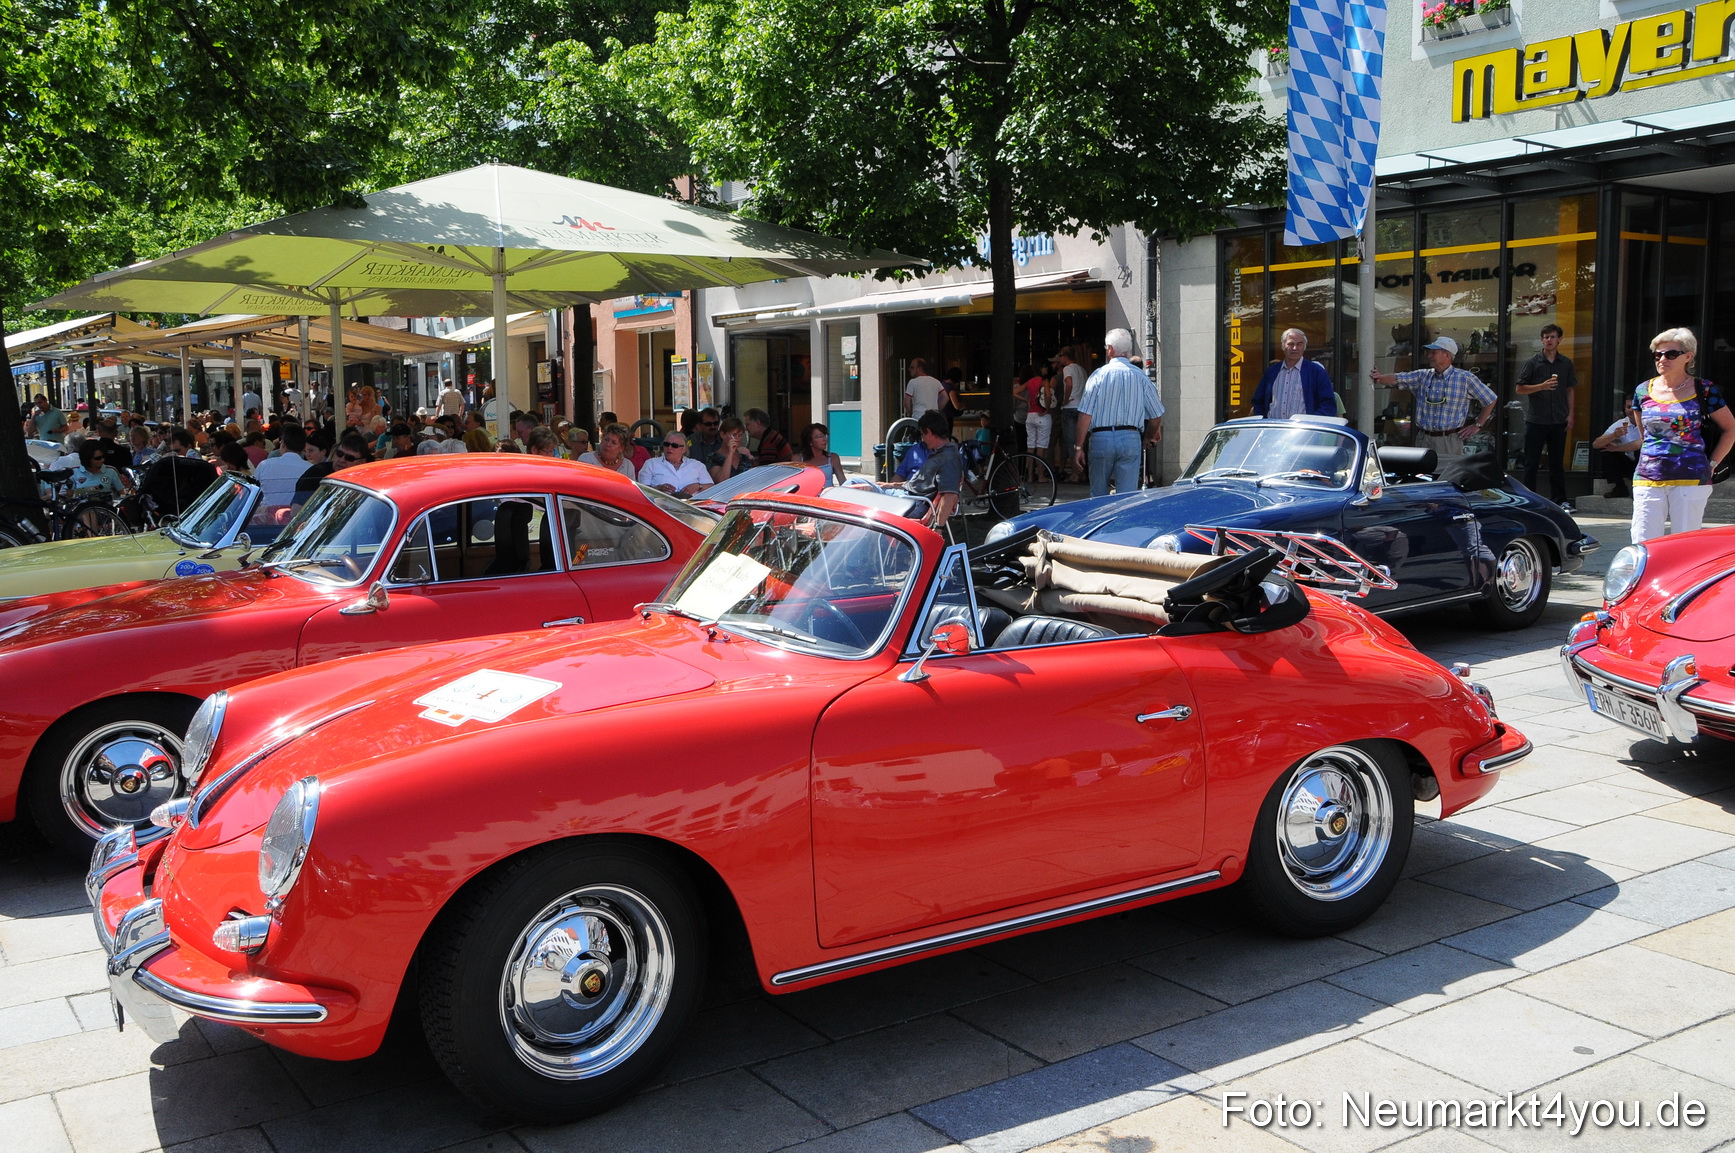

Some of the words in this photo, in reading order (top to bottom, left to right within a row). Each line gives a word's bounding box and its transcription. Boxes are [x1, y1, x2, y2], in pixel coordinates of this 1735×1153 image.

[1452, 0, 1735, 123] mayer
[524, 227, 668, 244] NEUMARKTER
[1230, 313, 1244, 405] mayer
[1617, 700, 1627, 721] F
